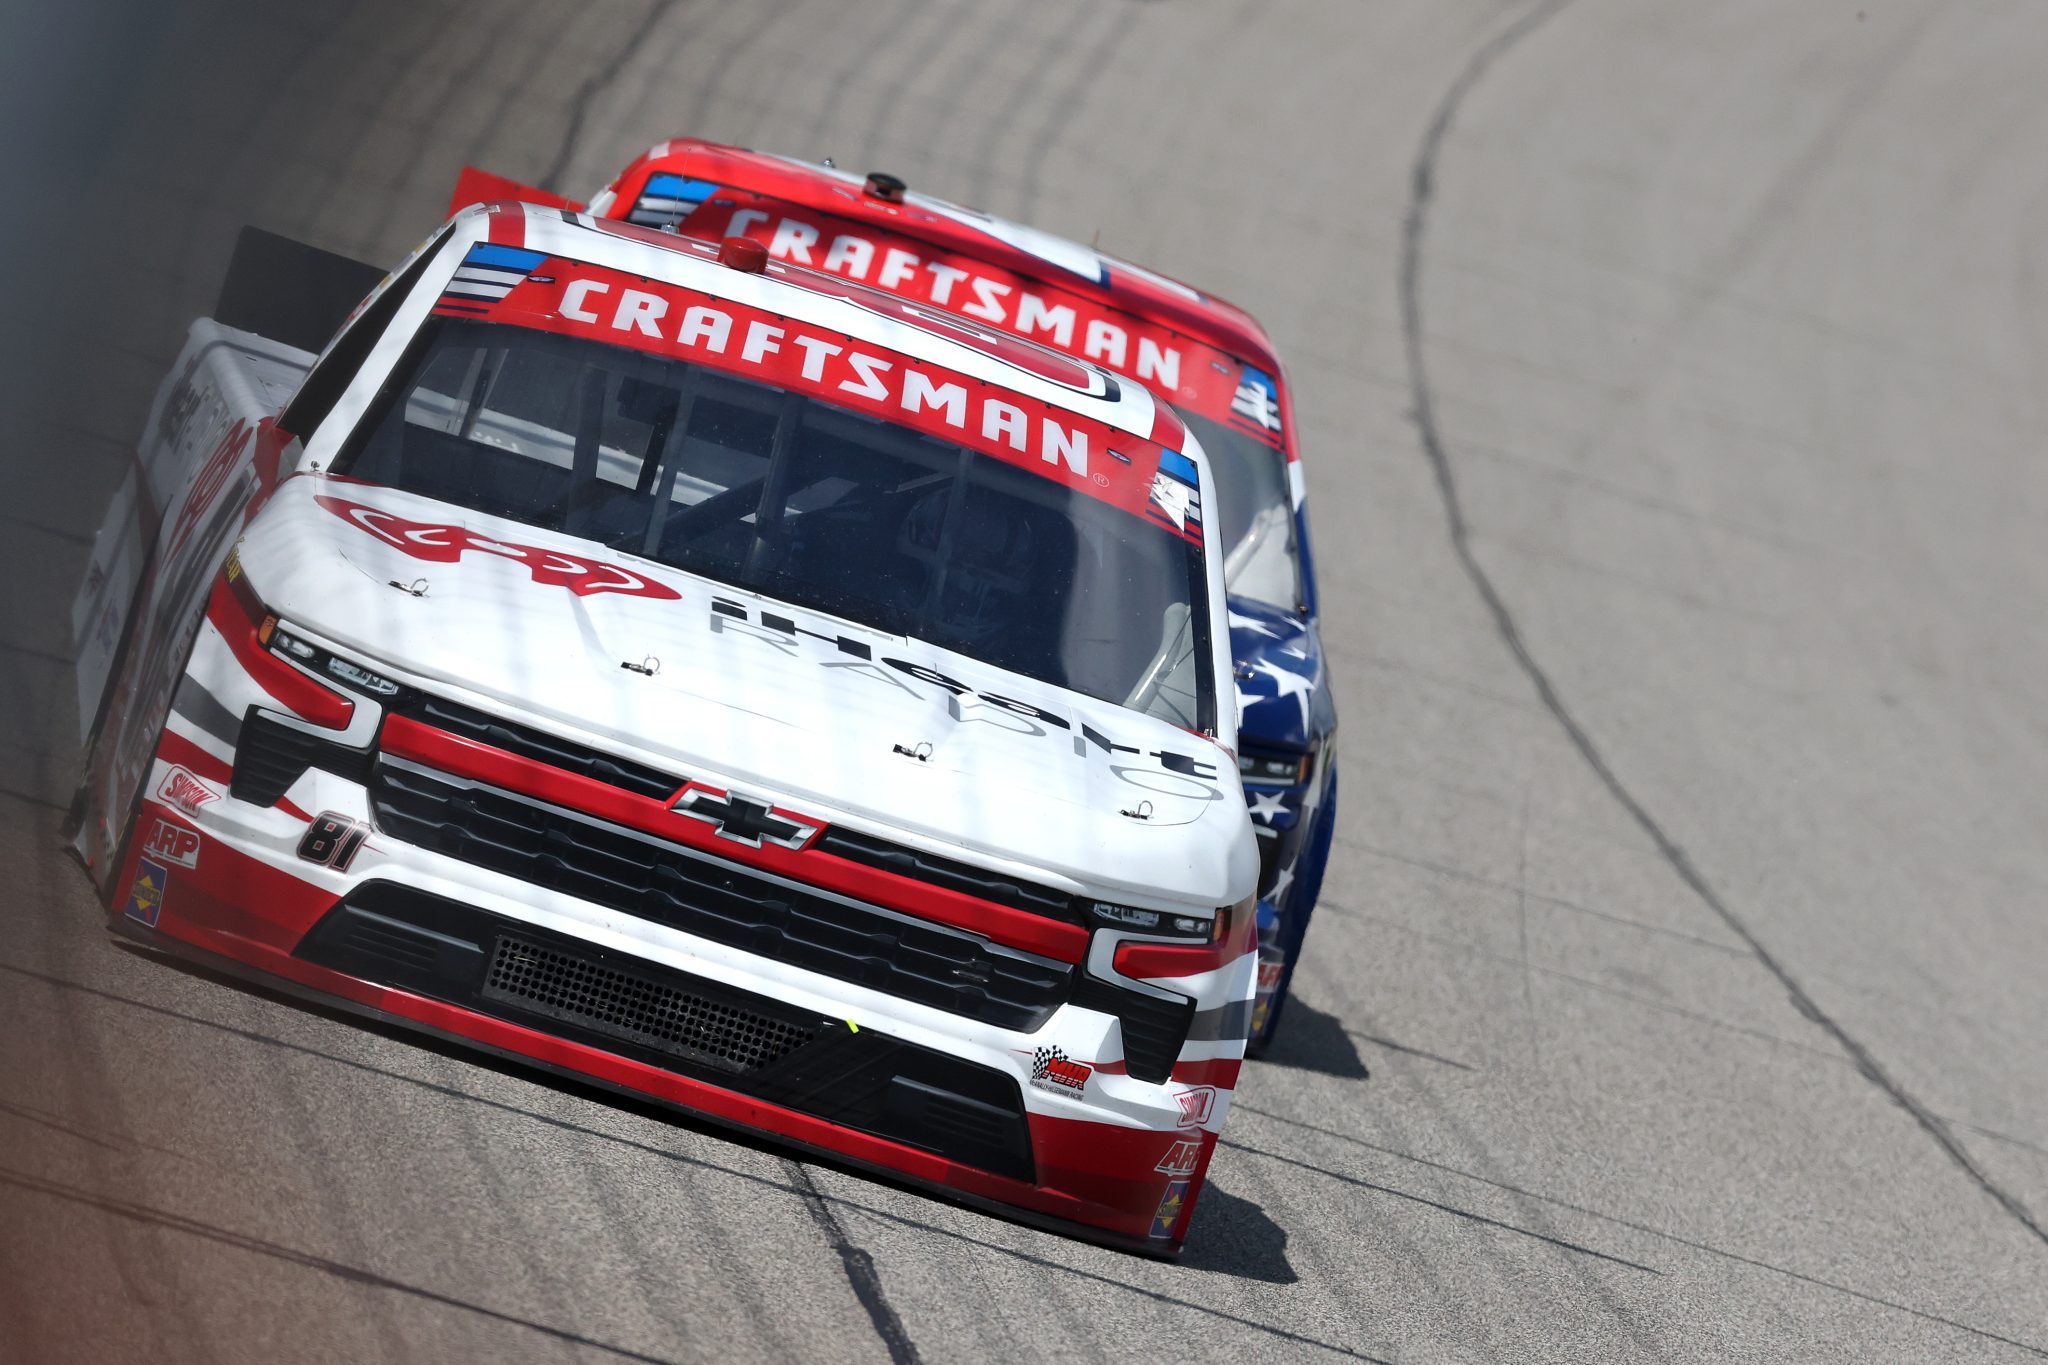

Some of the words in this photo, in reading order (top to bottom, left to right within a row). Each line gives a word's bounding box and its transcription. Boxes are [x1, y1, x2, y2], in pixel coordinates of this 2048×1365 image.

[725, 206, 1182, 392] CRAFTSMAN
[558, 278, 1089, 479] CRAFTSMAN
[145, 821, 198, 859] ARP
[297, 810, 373, 873] 81
